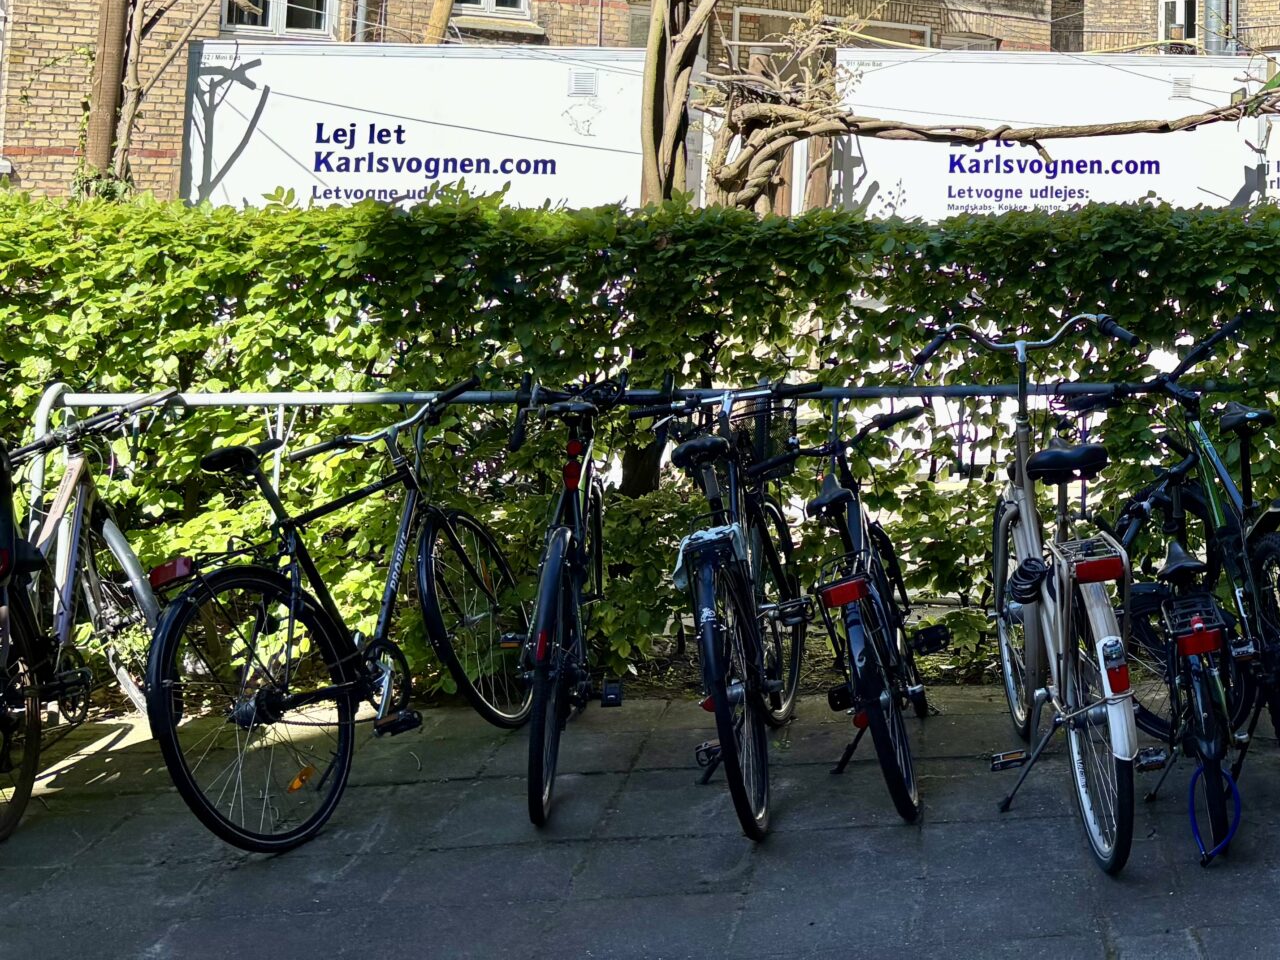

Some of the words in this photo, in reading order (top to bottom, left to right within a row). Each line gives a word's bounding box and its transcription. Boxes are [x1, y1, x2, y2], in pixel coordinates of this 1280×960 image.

[315, 123, 357, 149] Lej
[368, 123, 406, 144] let
[313, 151, 557, 179] Karlsvognen.com
[948, 154, 1161, 179] Karlsvognen.com
[947, 185, 1023, 202] Letvogne
[1029, 185, 1090, 202] udlejes:
